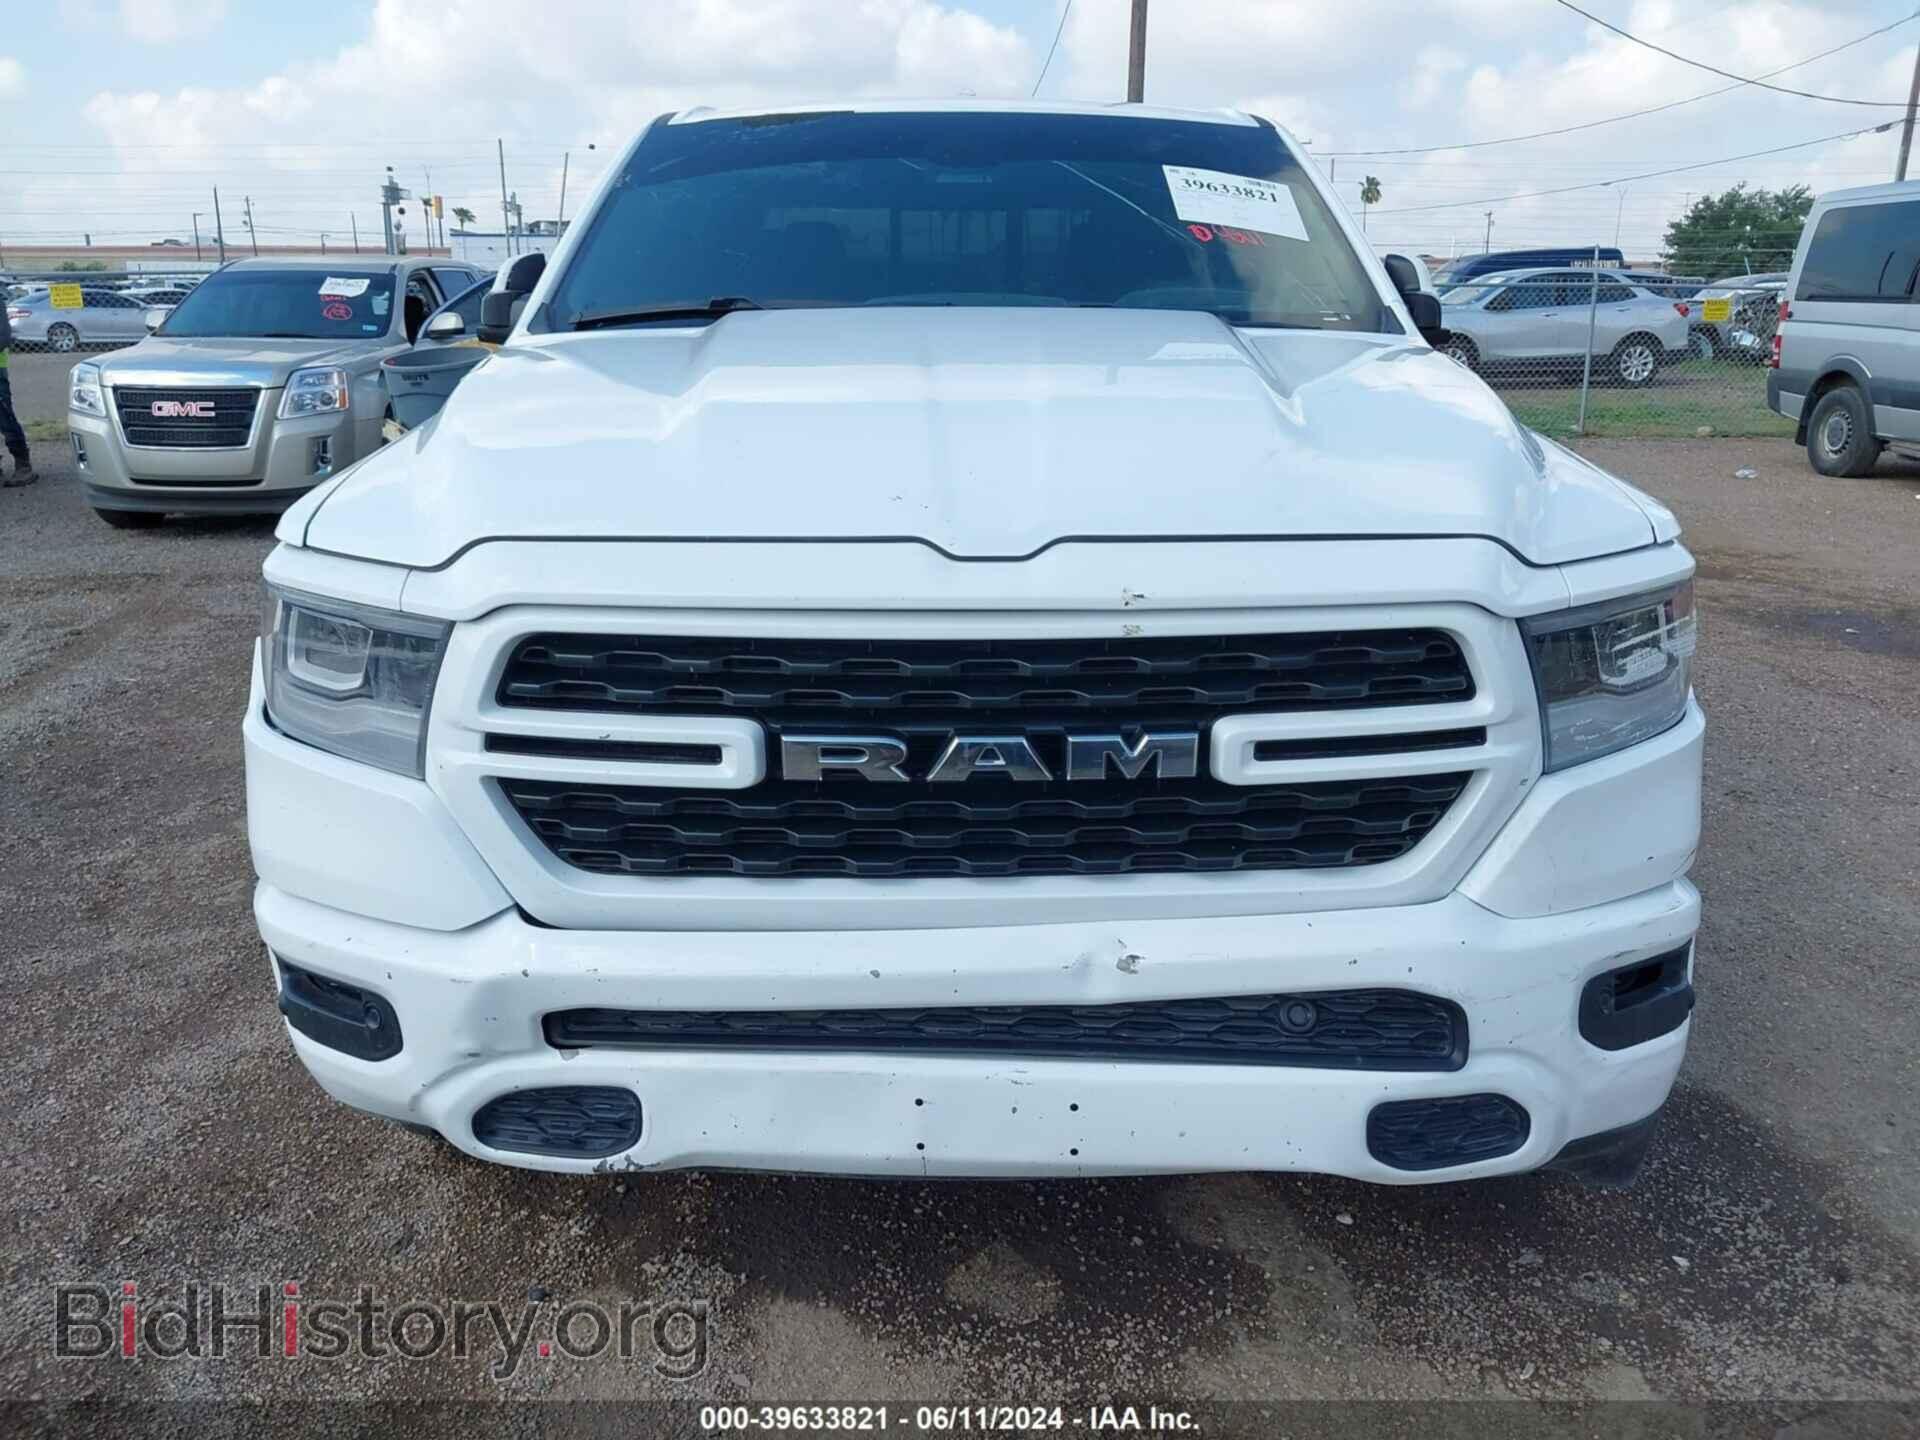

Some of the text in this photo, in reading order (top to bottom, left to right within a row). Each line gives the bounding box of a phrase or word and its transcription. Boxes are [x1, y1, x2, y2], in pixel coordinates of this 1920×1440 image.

[1181, 178, 1277, 203] 39633821
[151, 401, 216, 417] GMC
[781, 734, 1199, 781] RAM
